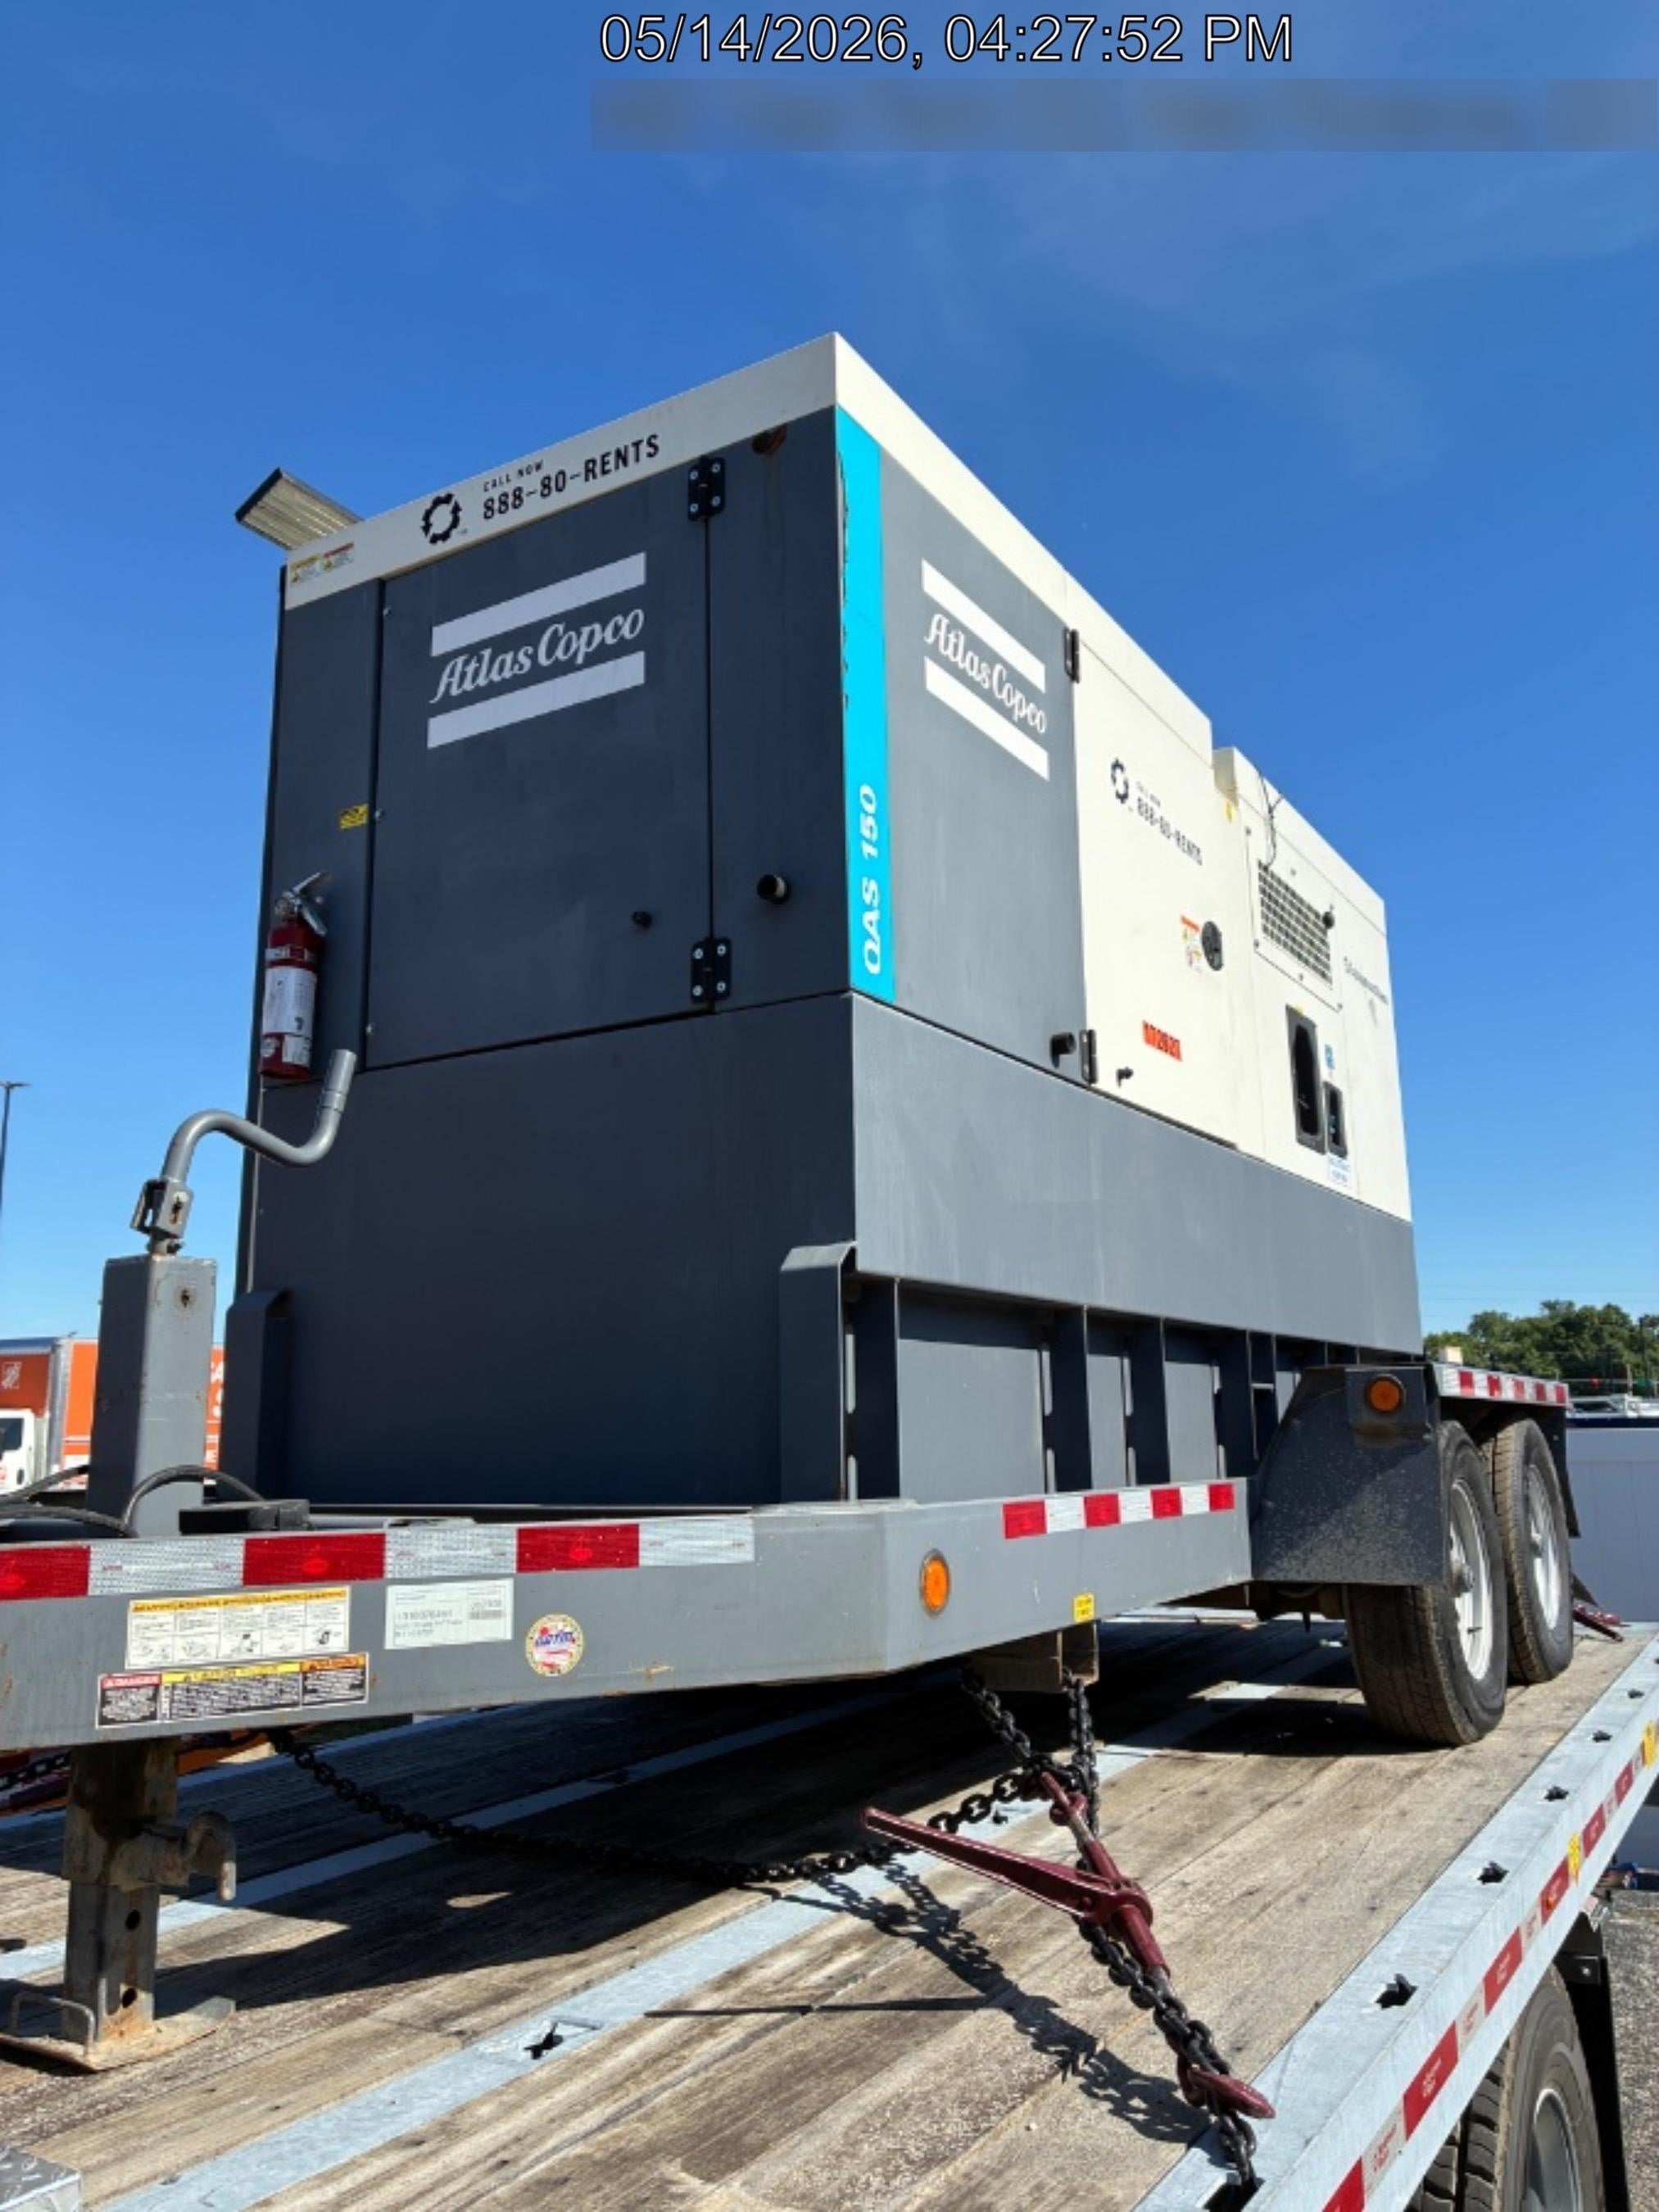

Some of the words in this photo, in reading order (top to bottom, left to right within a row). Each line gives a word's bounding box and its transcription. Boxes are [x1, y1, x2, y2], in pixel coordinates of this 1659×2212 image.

[483, 474, 512, 492] CALL
[518, 460, 543, 478] NOW
[483, 433, 660, 519] 888-80-RENTS
[859, 783, 879, 859] 150
